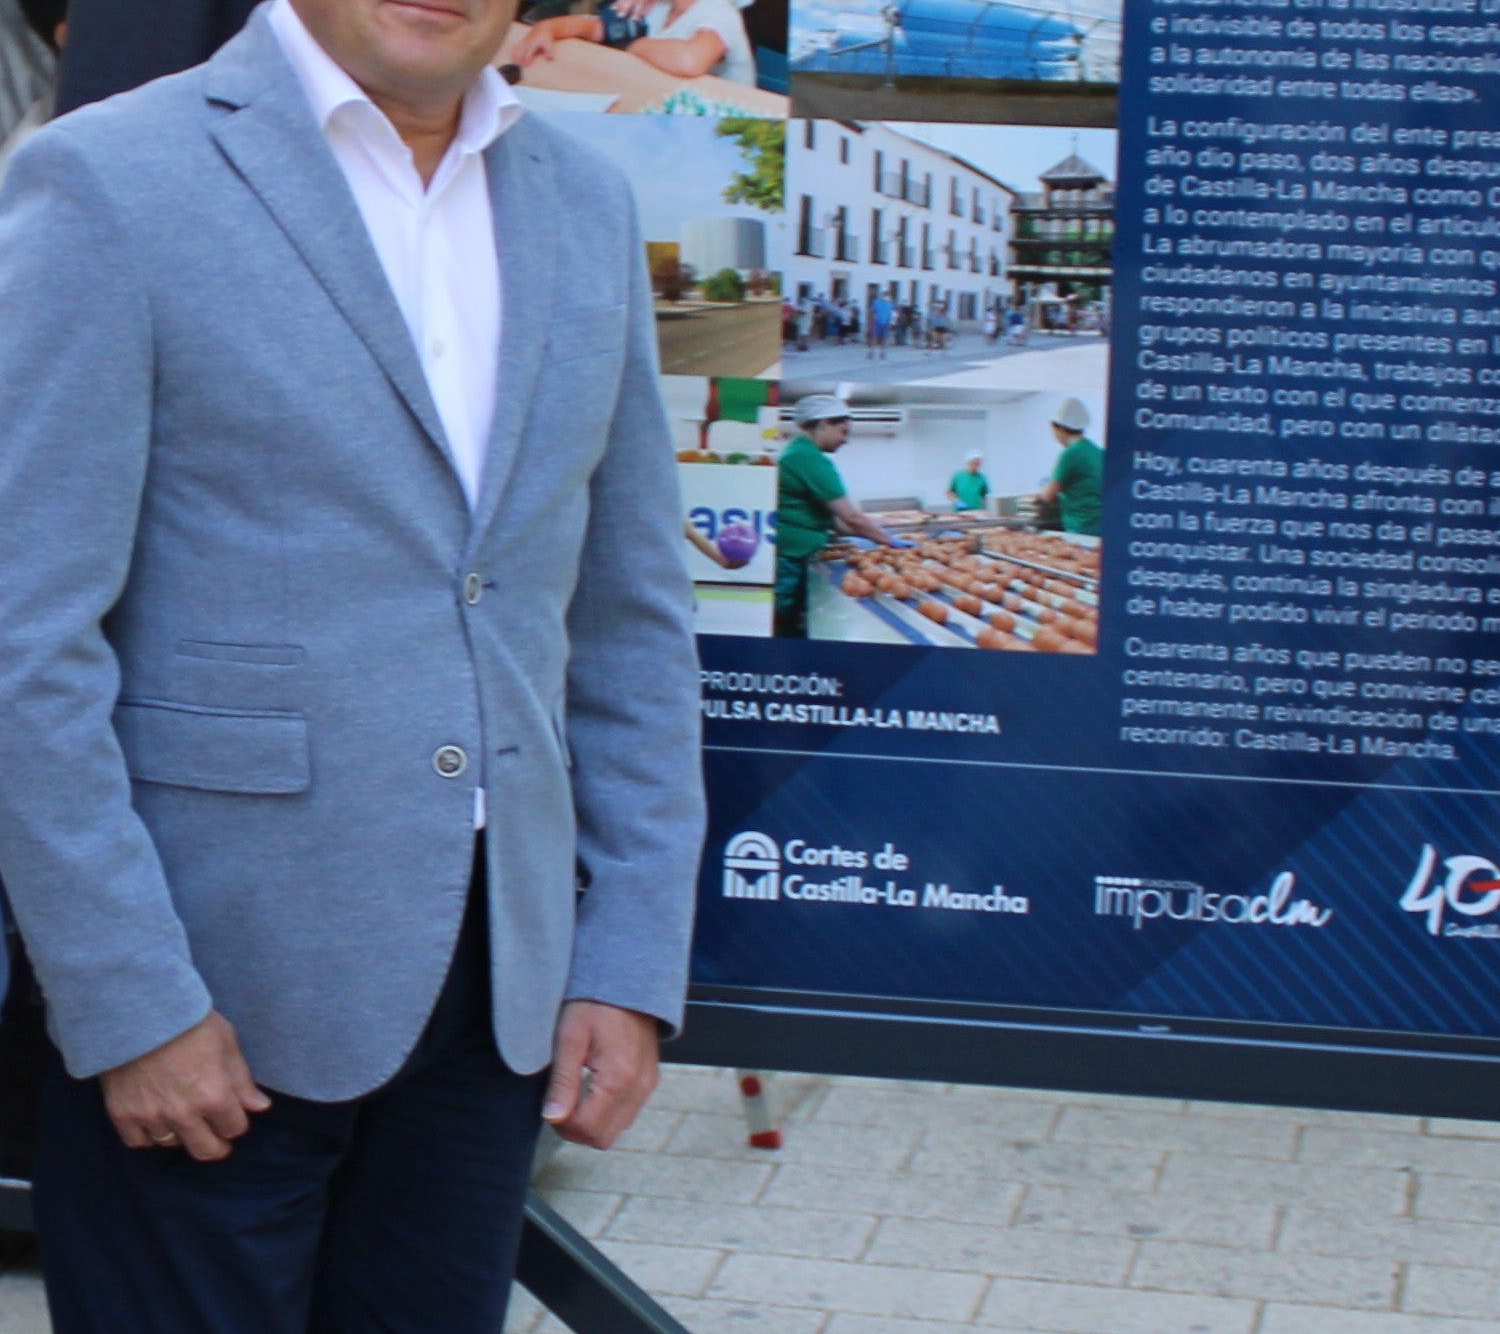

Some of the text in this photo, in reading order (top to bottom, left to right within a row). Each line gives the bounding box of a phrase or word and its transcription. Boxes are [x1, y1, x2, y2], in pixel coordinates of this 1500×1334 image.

[1148, 70, 1275, 97] solidaridad
[1275, 75, 1338, 99] entre
[1340, 77, 1407, 101] todas
[1146, 114, 1178, 137] La
[1350, 121, 1389, 144] del
[1392, 122, 1449, 146] ente
[1195, 145, 1236, 169] dio
[1308, 149, 1356, 173] dos
[1142, 207, 1161, 224] a
[1164, 203, 1190, 226] lo
[1192, 204, 1351, 236] contemplado
[1353, 215, 1386, 233] en
[1388, 211, 1414, 234] el
[1140, 260, 1280, 288] ciudadanos
[1282, 271, 1315, 289] en
[1318, 267, 1497, 300] ayuntamientos
[1137, 324, 1223, 349] grupos
[1332, 327, 1453, 358] presentes
[1456, 337, 1488, 355] en
[1279, 418, 1336, 441] pero
[1338, 420, 1386, 439] con
[1389, 423, 1422, 441] un
[1125, 592, 1157, 616] de
[1158, 594, 1226, 619] haber
[1228, 598, 1309, 628] podido
[1311, 602, 1361, 626] vivir
[1363, 605, 1387, 628] el
[1389, 606, 1479, 637] periodo
[764, 703, 904, 729] CASTILLA-LA
[906, 710, 1001, 734] MANCHA
[1121, 692, 1261, 725] permanente
[1427, 708, 1460, 732] de
[1234, 726, 1357, 755] Castilla-La
[784, 839, 909, 872] Cortes de
[783, 874, 1030, 914] Castilla-La Mancha
